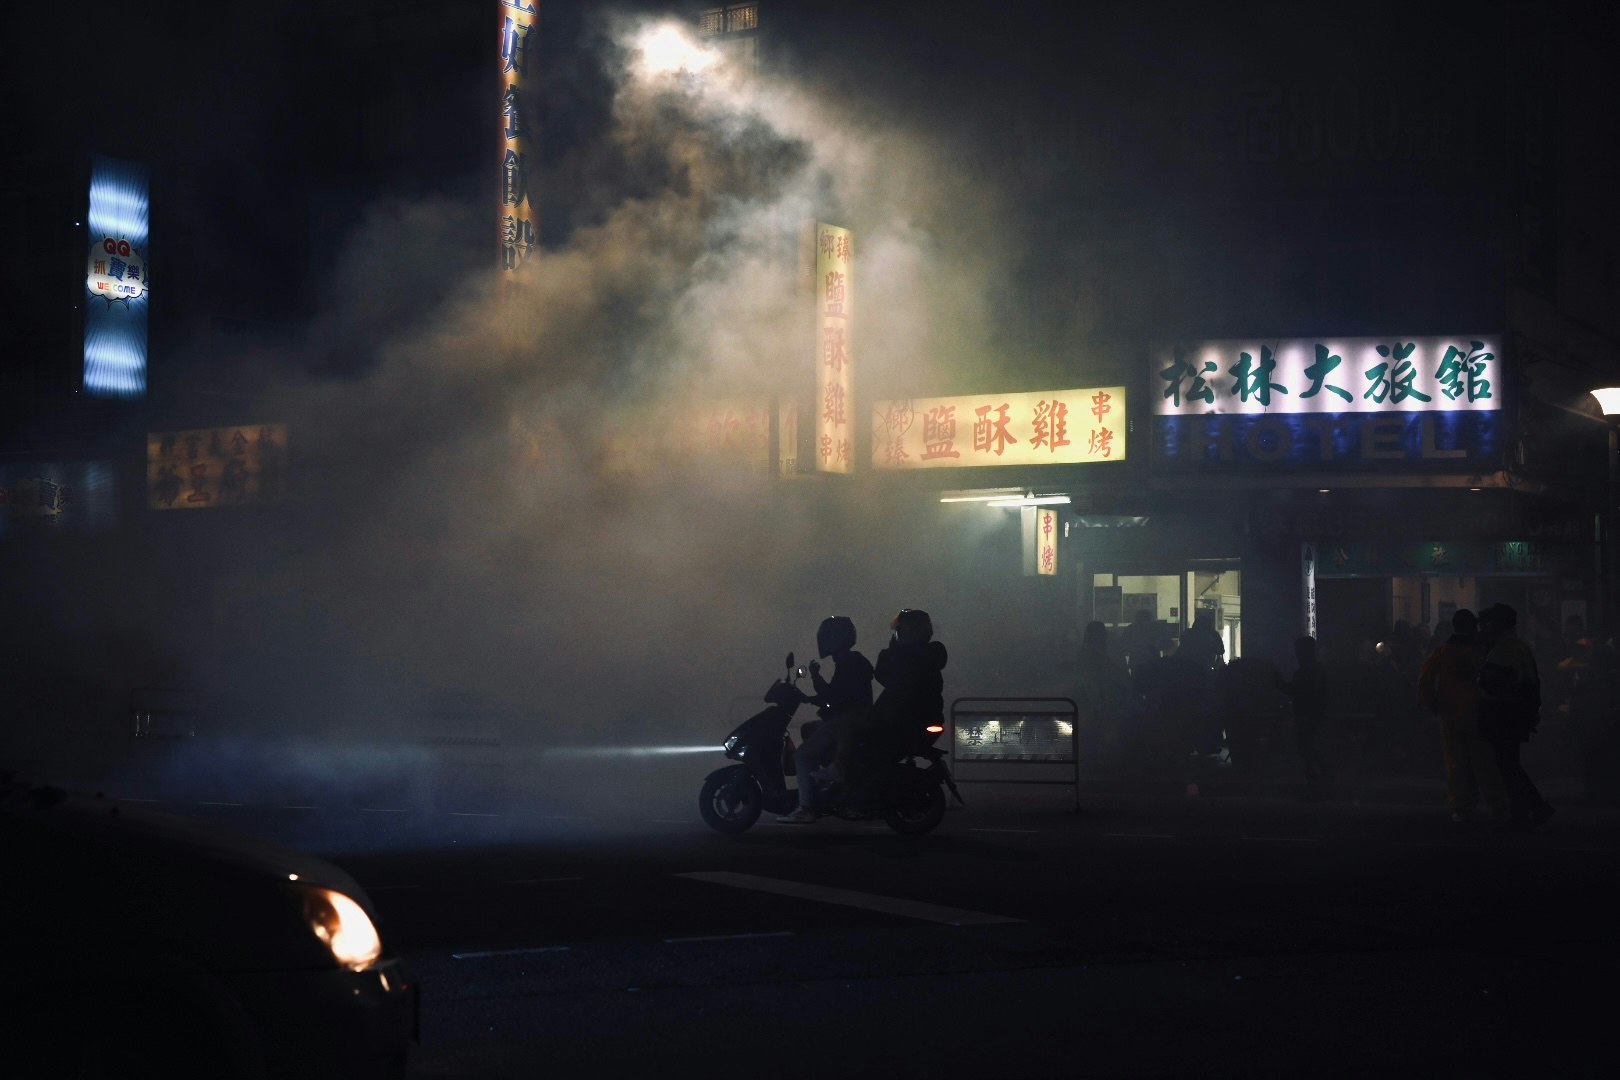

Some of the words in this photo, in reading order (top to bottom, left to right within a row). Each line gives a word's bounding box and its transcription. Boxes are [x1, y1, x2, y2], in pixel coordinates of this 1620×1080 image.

[94, 257, 140, 281] 抓寶樂
[104, 237, 130, 257] QQ
[823, 271, 849, 428] 鹽酥雞
[1160, 341, 1496, 407] 松林大旅館
[919, 399, 1071, 461] 鹽酥雞
[1087, 391, 1113, 458] 串烤
[1190, 415, 1469, 460] HOTEL
[1042, 513, 1054, 571] 串烤
